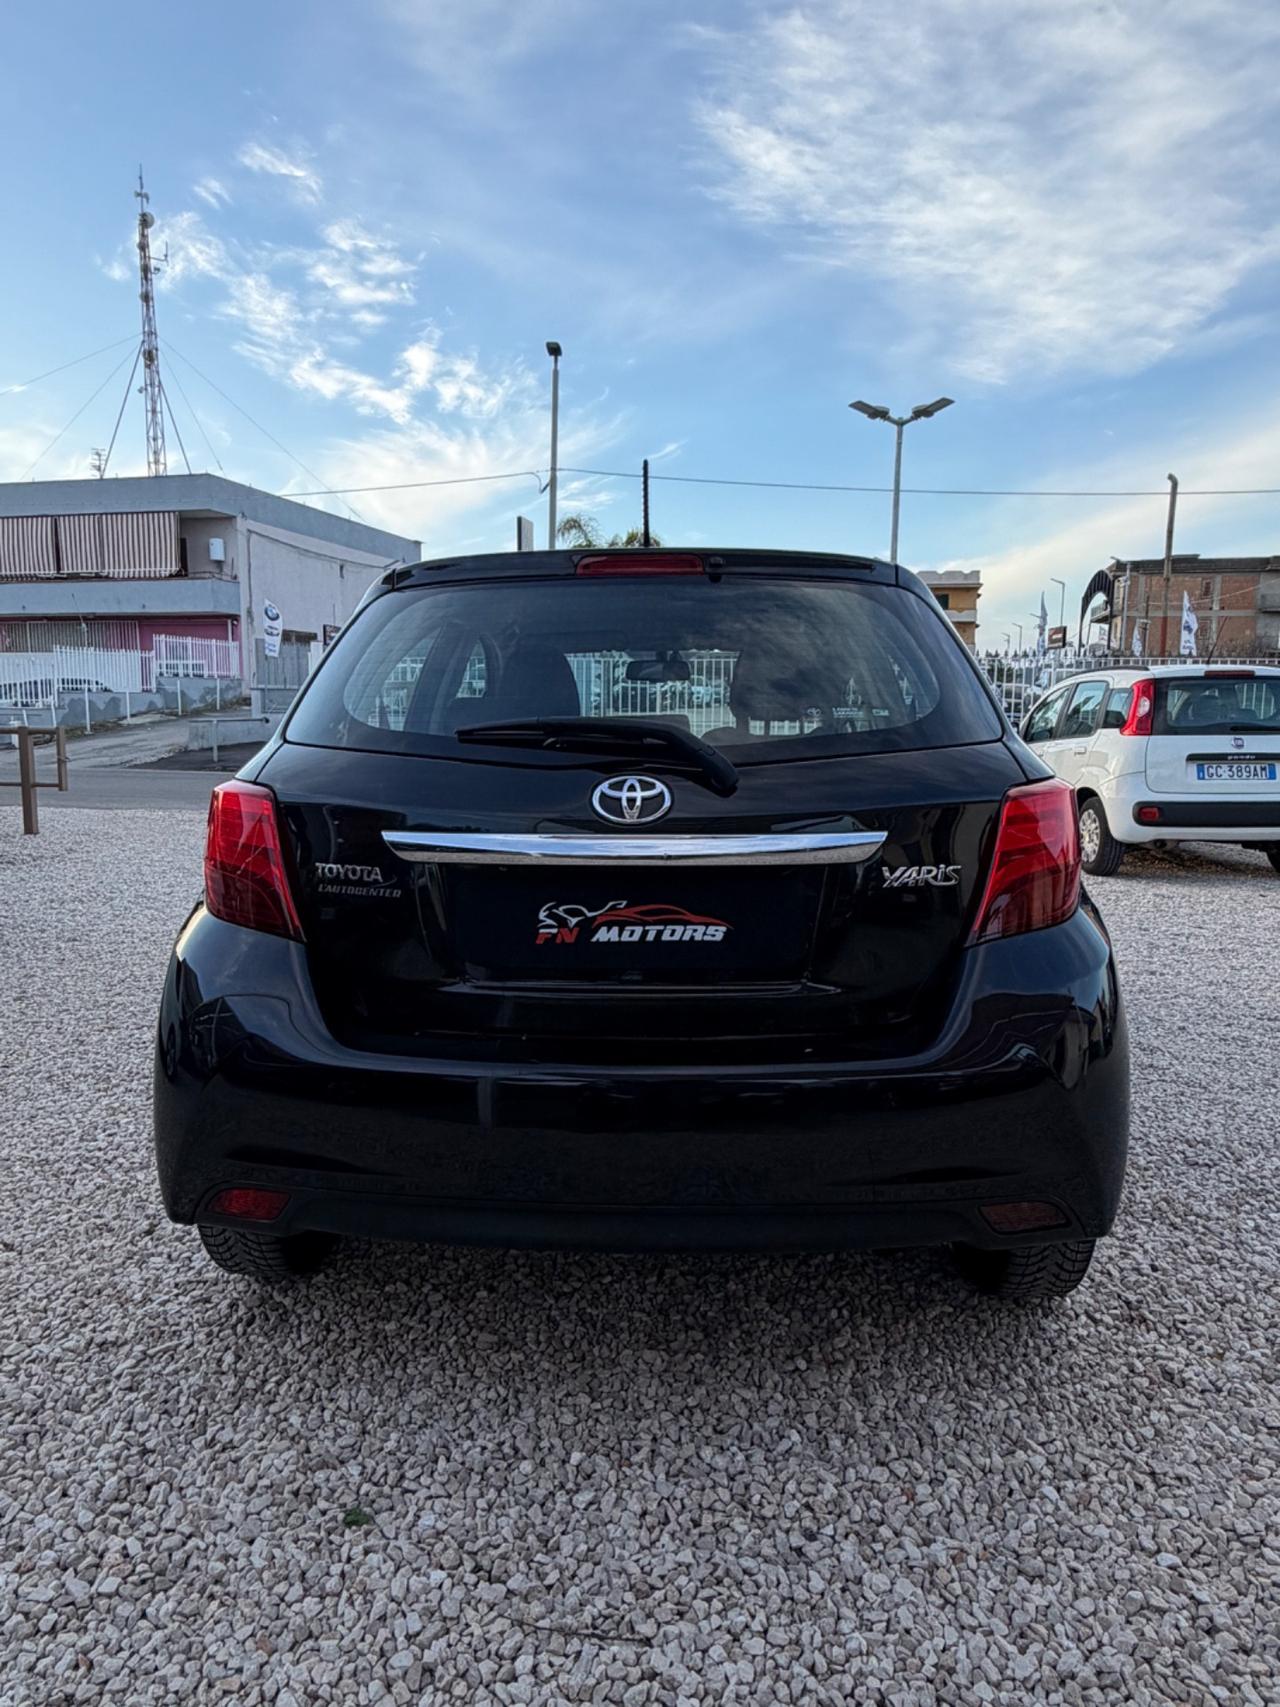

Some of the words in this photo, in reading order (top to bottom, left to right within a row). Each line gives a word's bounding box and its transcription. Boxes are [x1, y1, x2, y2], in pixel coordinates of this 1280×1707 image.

[1206, 765, 1223, 778] GC
[1227, 765, 1268, 778] 389AM
[315, 862, 384, 882] TOYOTA
[318, 883, 402, 898] L'AUTOCENTER
[535, 927, 580, 945] FN
[590, 925, 728, 943] MOTORS
